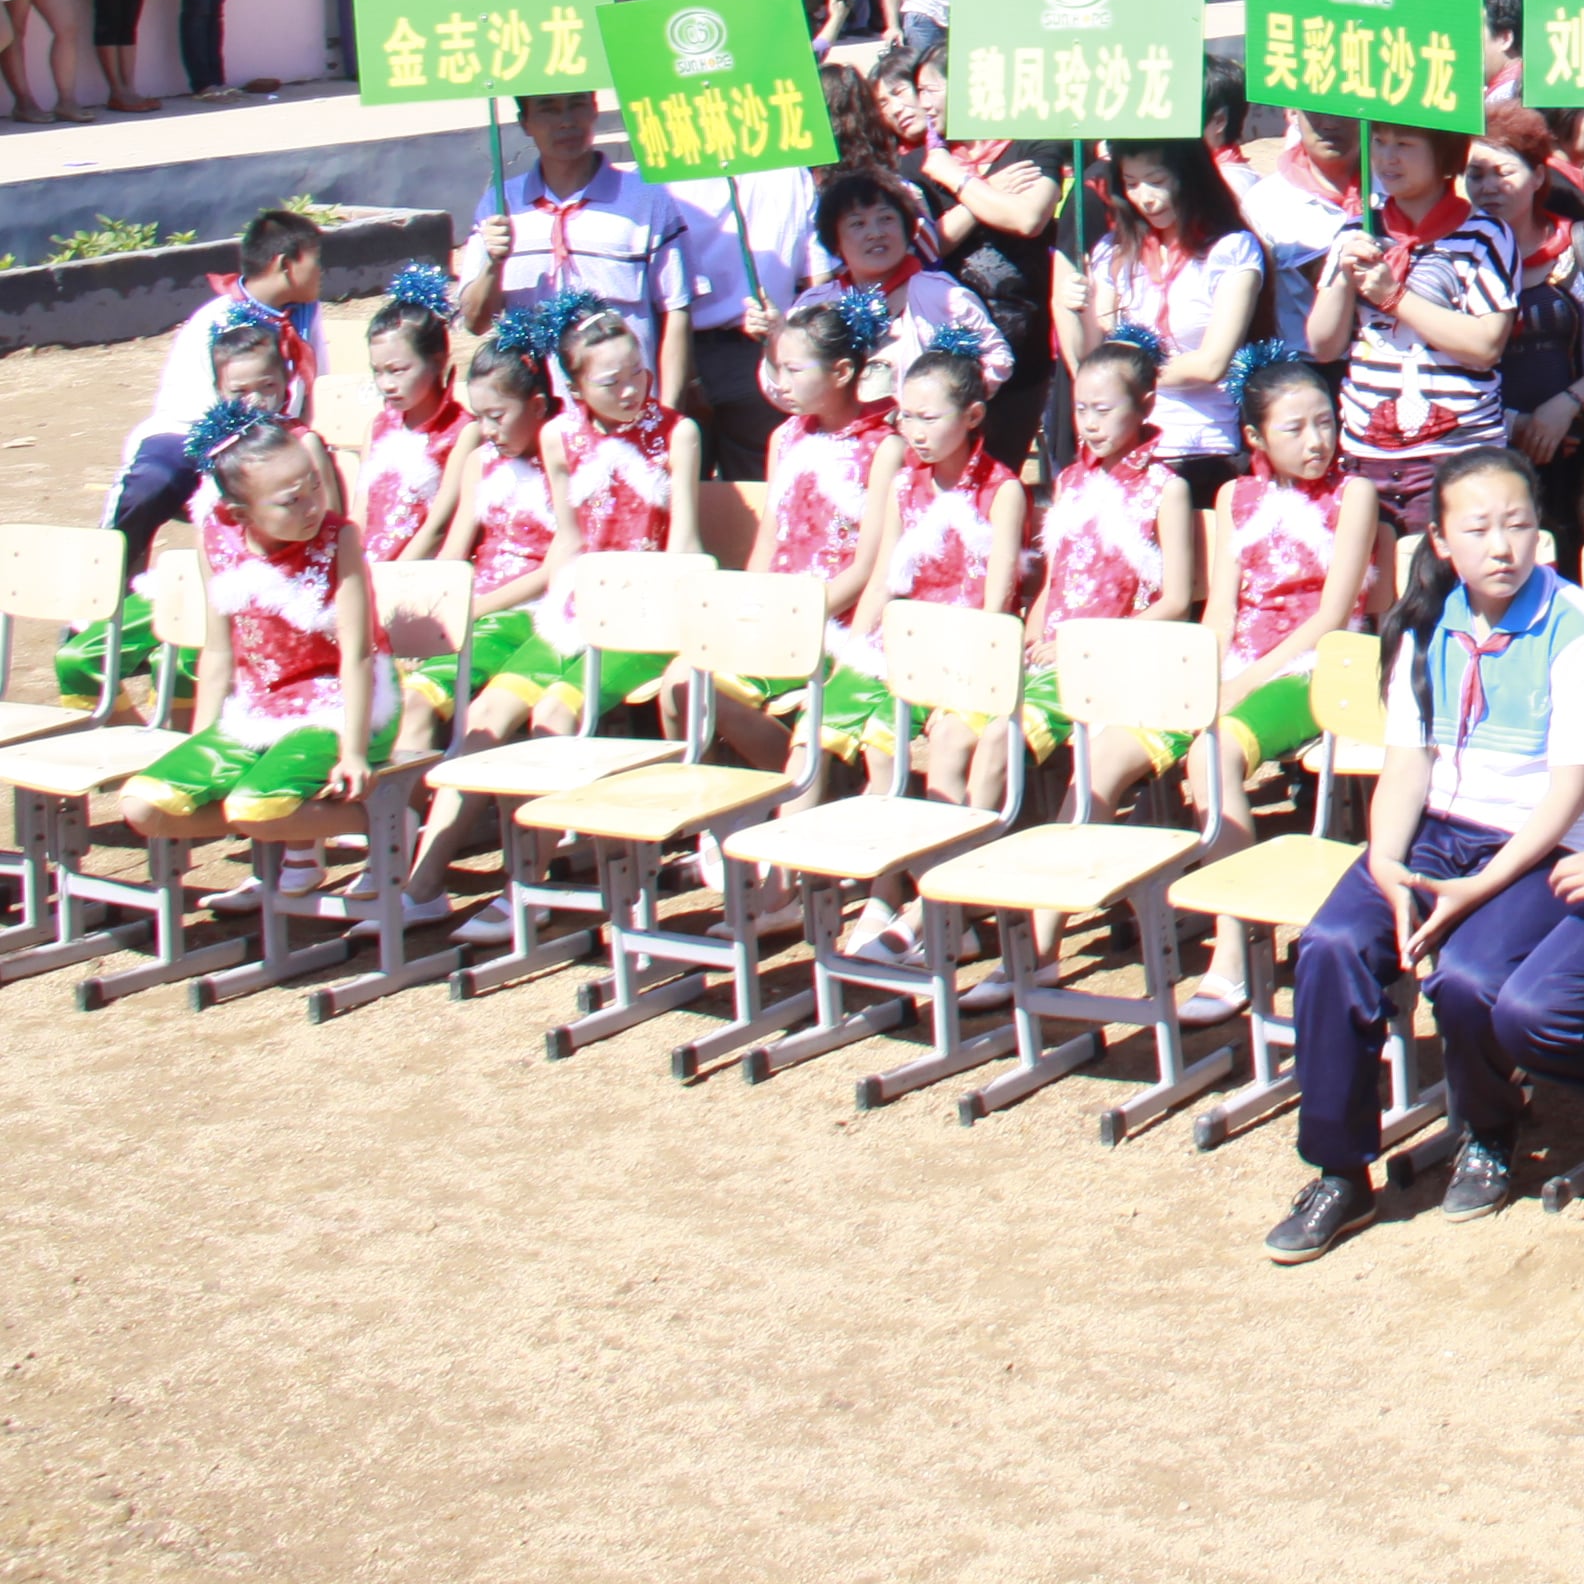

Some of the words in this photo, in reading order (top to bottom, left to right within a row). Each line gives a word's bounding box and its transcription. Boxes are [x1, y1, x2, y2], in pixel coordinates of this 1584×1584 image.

[383, 6, 588, 88] 金志沙龙
[968, 44, 1174, 121] 魏凤玲沙龙
[1264, 12, 1458, 112] 吴彩虹沙龙
[629, 78, 814, 169] 孙琳琳沙龙
